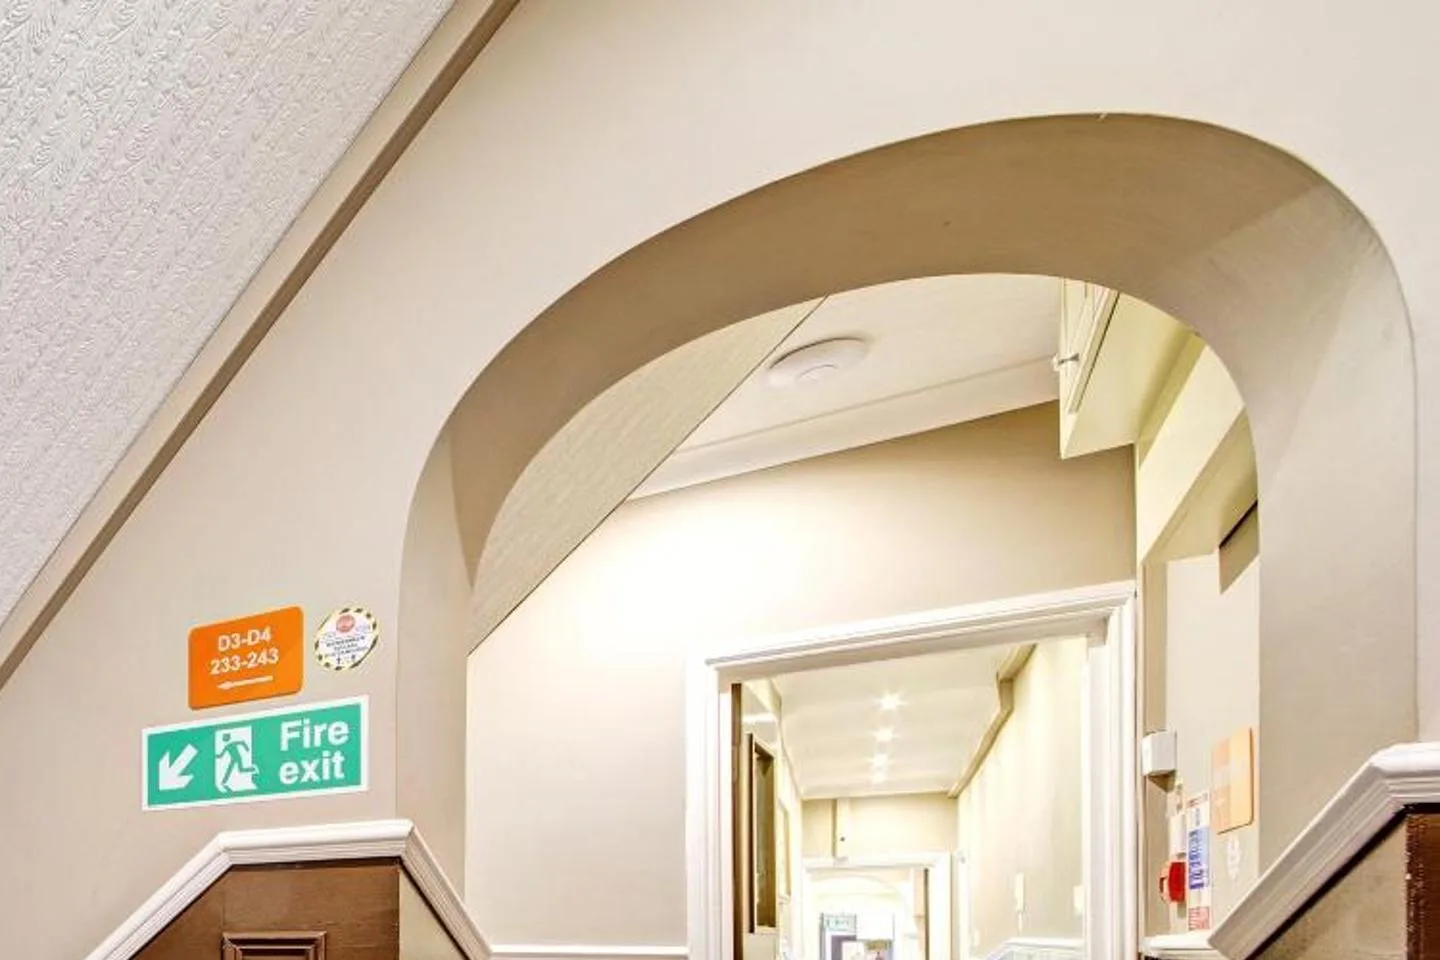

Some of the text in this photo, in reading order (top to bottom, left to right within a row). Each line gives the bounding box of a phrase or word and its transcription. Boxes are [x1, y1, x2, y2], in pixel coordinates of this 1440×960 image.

[217, 625, 272, 652] D3-D4
[209, 647, 280, 676] 233-243
[279, 717, 350, 752] Fire
[278, 749, 346, 786] exit
